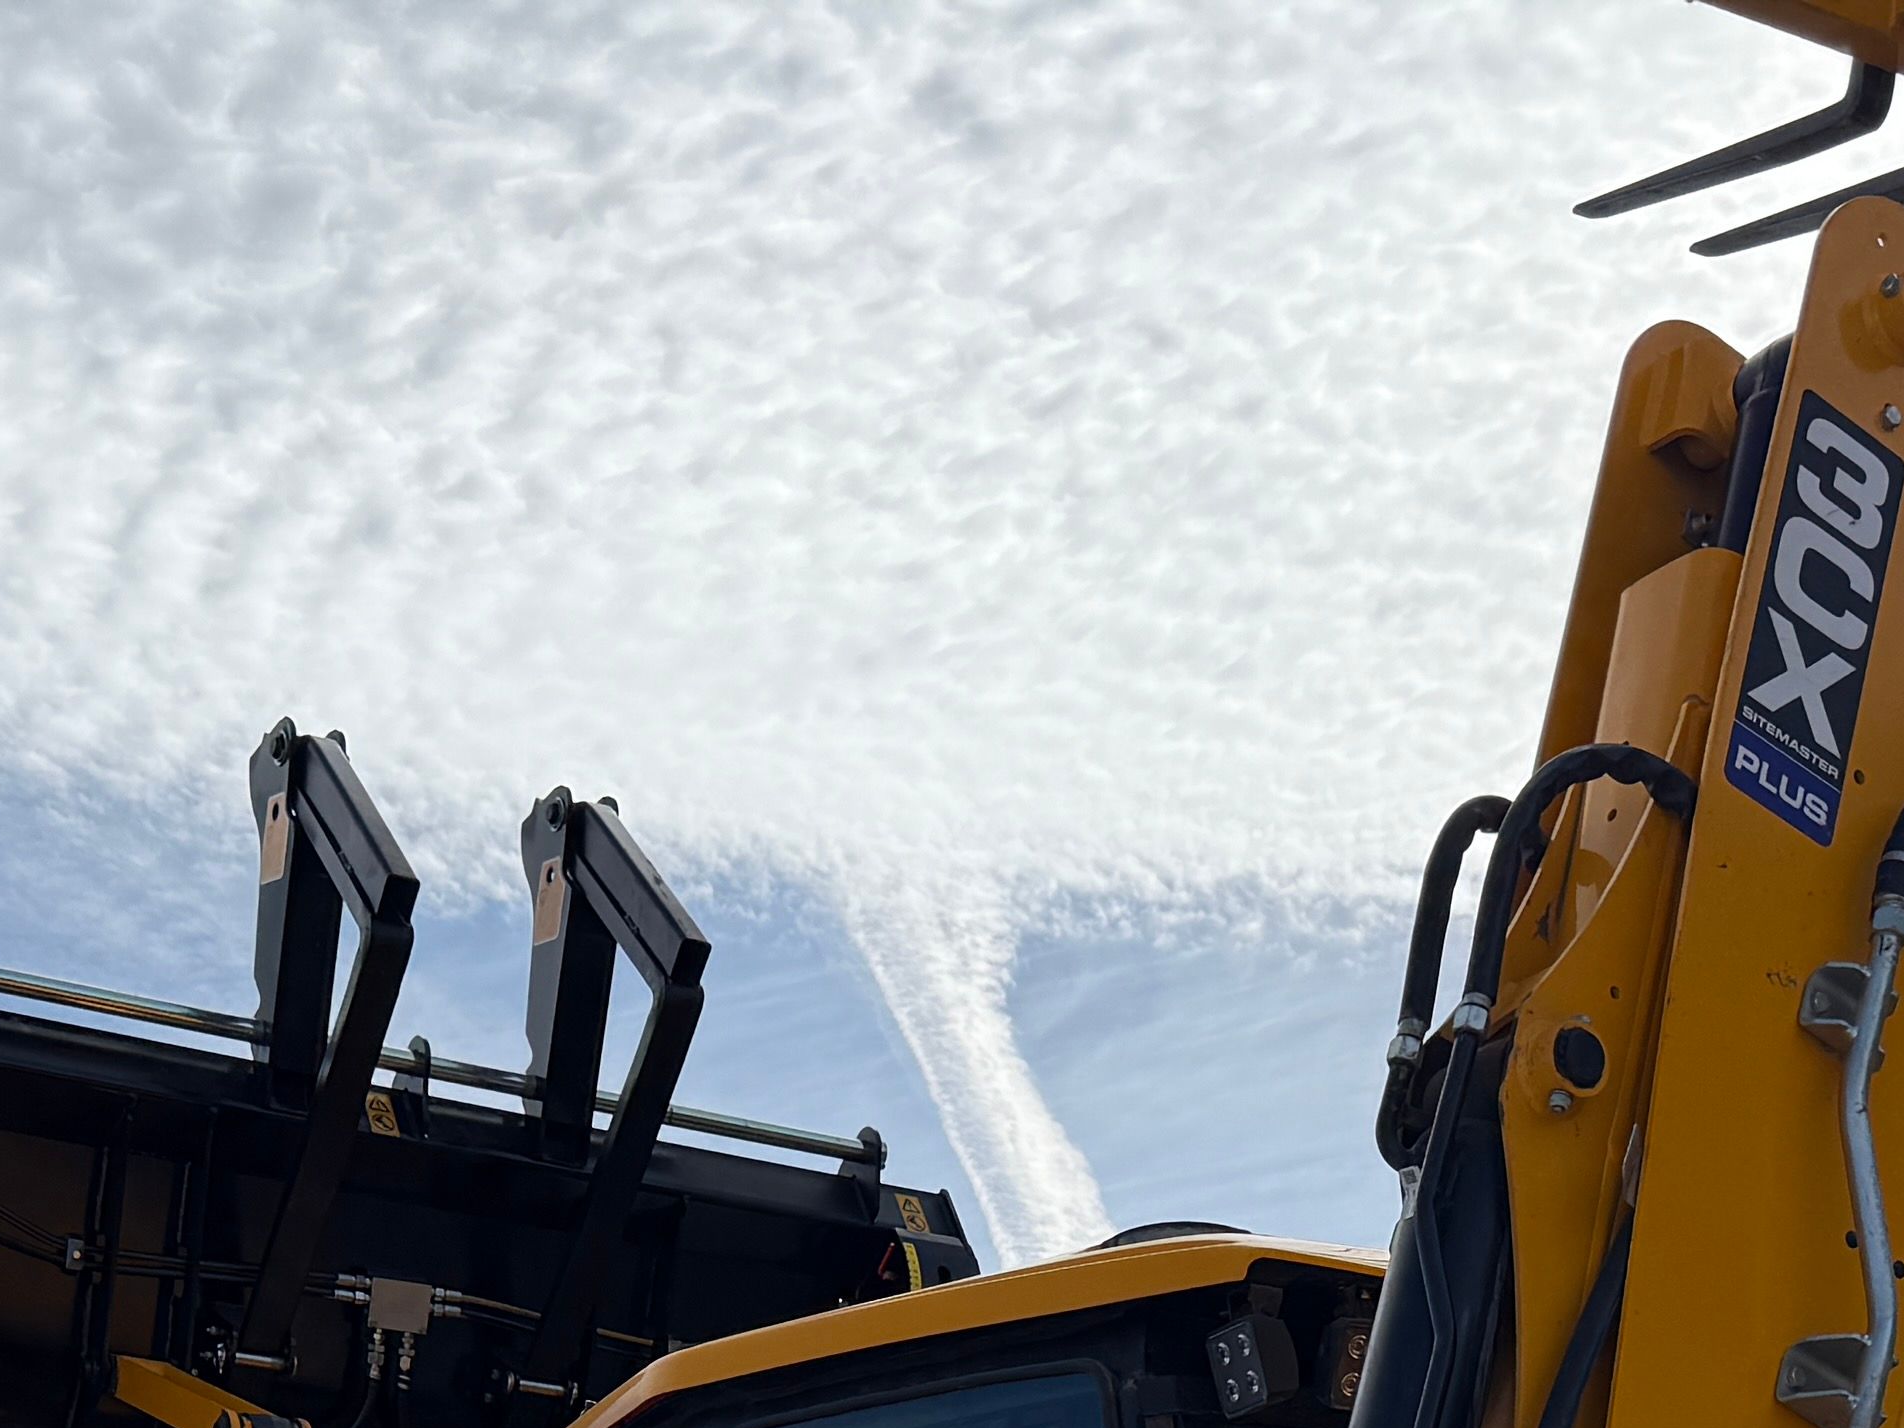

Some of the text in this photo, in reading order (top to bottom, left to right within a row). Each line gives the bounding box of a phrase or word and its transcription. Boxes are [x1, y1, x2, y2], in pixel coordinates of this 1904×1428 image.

[1747, 418, 1890, 760] 3CX
[1742, 705, 1840, 780] SITEMASTER
[1734, 744, 1829, 828] PLUS
